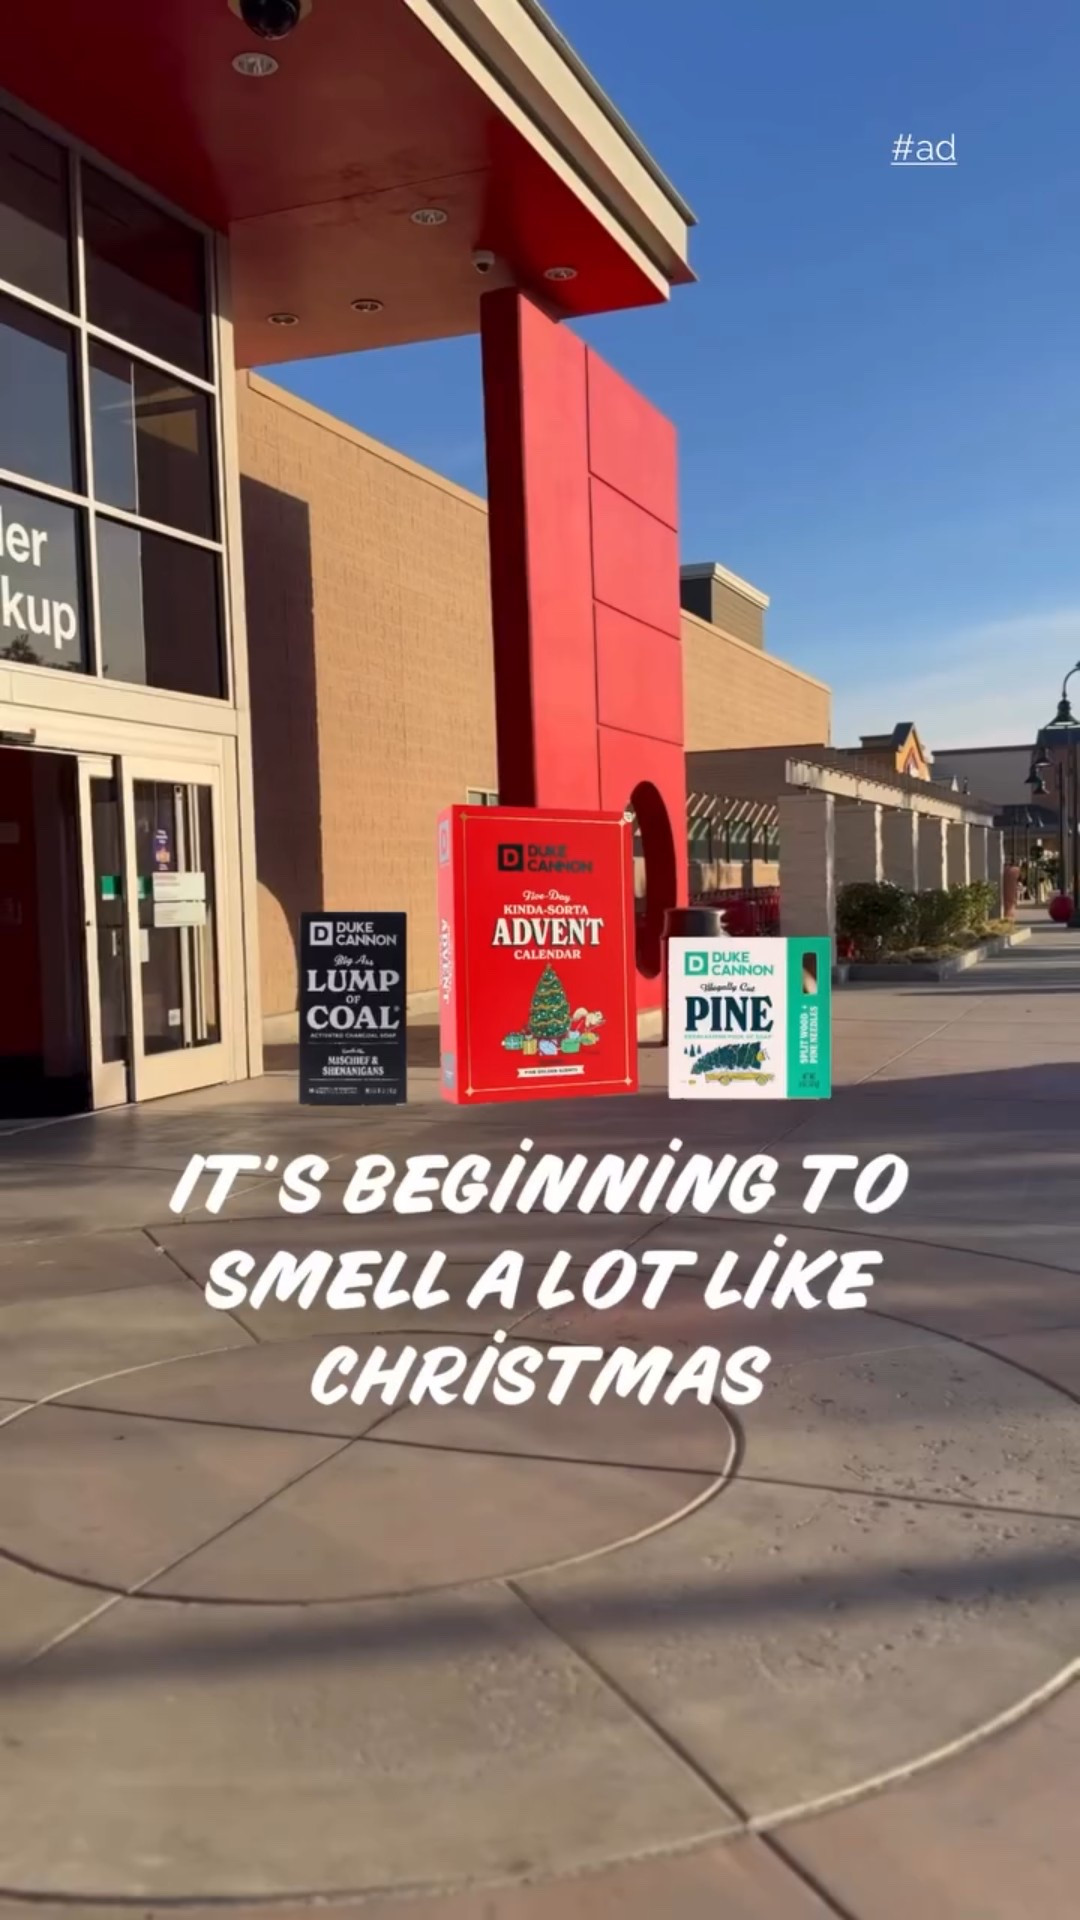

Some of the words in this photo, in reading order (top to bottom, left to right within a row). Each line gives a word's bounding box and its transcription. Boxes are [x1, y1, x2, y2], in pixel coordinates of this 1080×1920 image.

[527, 844, 567, 857] DUKE
[527, 860, 593, 873] CANNON
[503, 904, 589, 915] KINDA-SORTA
[336, 921, 375, 934] DUKE
[492, 917, 606, 947] ADVENT
[335, 934, 398, 946] CANNON
[334, 953, 354, 967] Big
[513, 949, 582, 961] CALENDAR
[712, 951, 750, 963] DUKE
[711, 964, 774, 976] CANNON
[306, 969, 400, 993] LUMP
[739, 982, 756, 993] Cut
[345, 995, 361, 1005] OF
[684, 995, 774, 1033] PINE
[327, 1055, 370, 1066] MISCHIEF
[371, 1055, 379, 1066] &
[321, 1066, 385, 1077] SHENANIGANS
